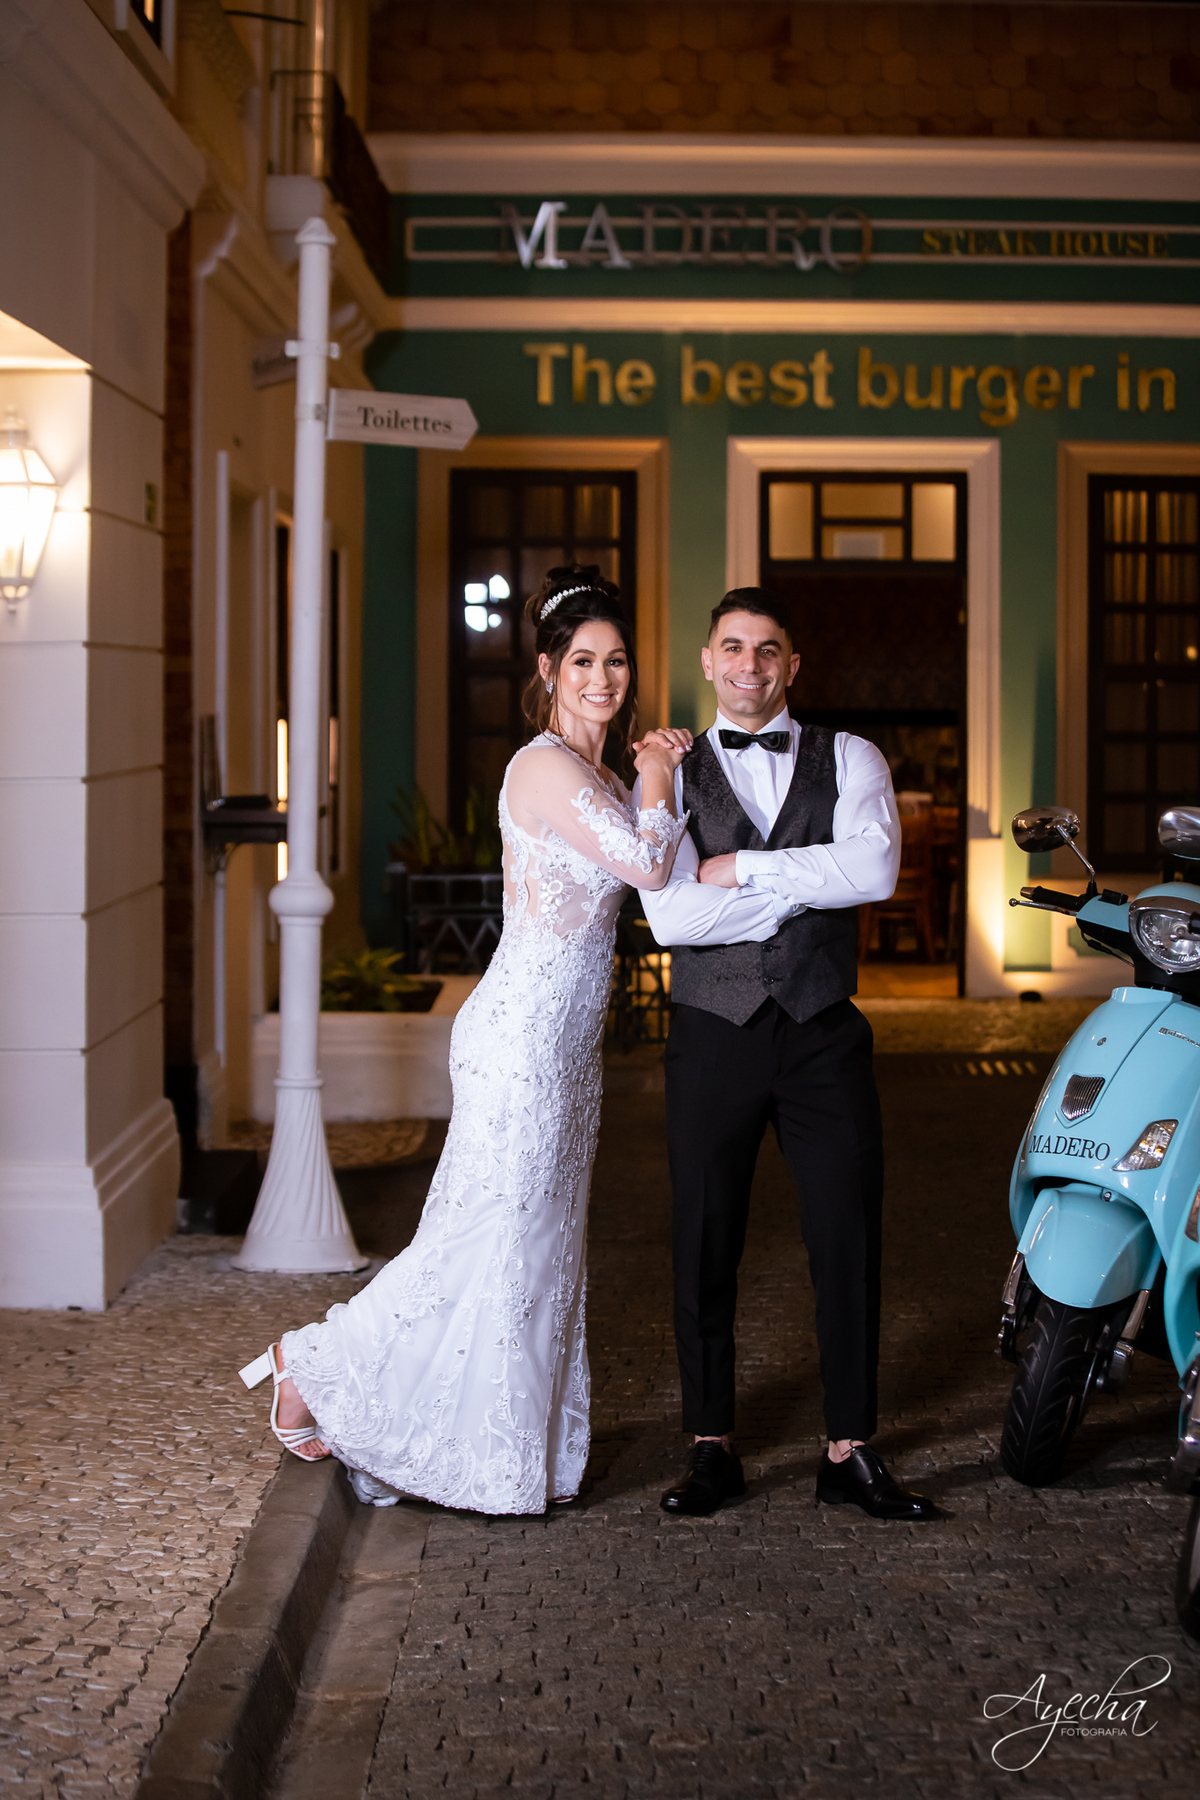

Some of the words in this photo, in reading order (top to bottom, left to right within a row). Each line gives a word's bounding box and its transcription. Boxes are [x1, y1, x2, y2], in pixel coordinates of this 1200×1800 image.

[496, 200, 873, 273] MADERO
[922, 229, 1038, 256] STEAK
[1049, 230, 1169, 259] HOUSE
[523, 342, 656, 406] The
[681, 345, 835, 409] best
[857, 347, 1095, 427] burger
[1117, 353, 1176, 412] in
[357, 406, 452, 434] Toilettes
[1028, 1135, 1111, 1162] MADERO
